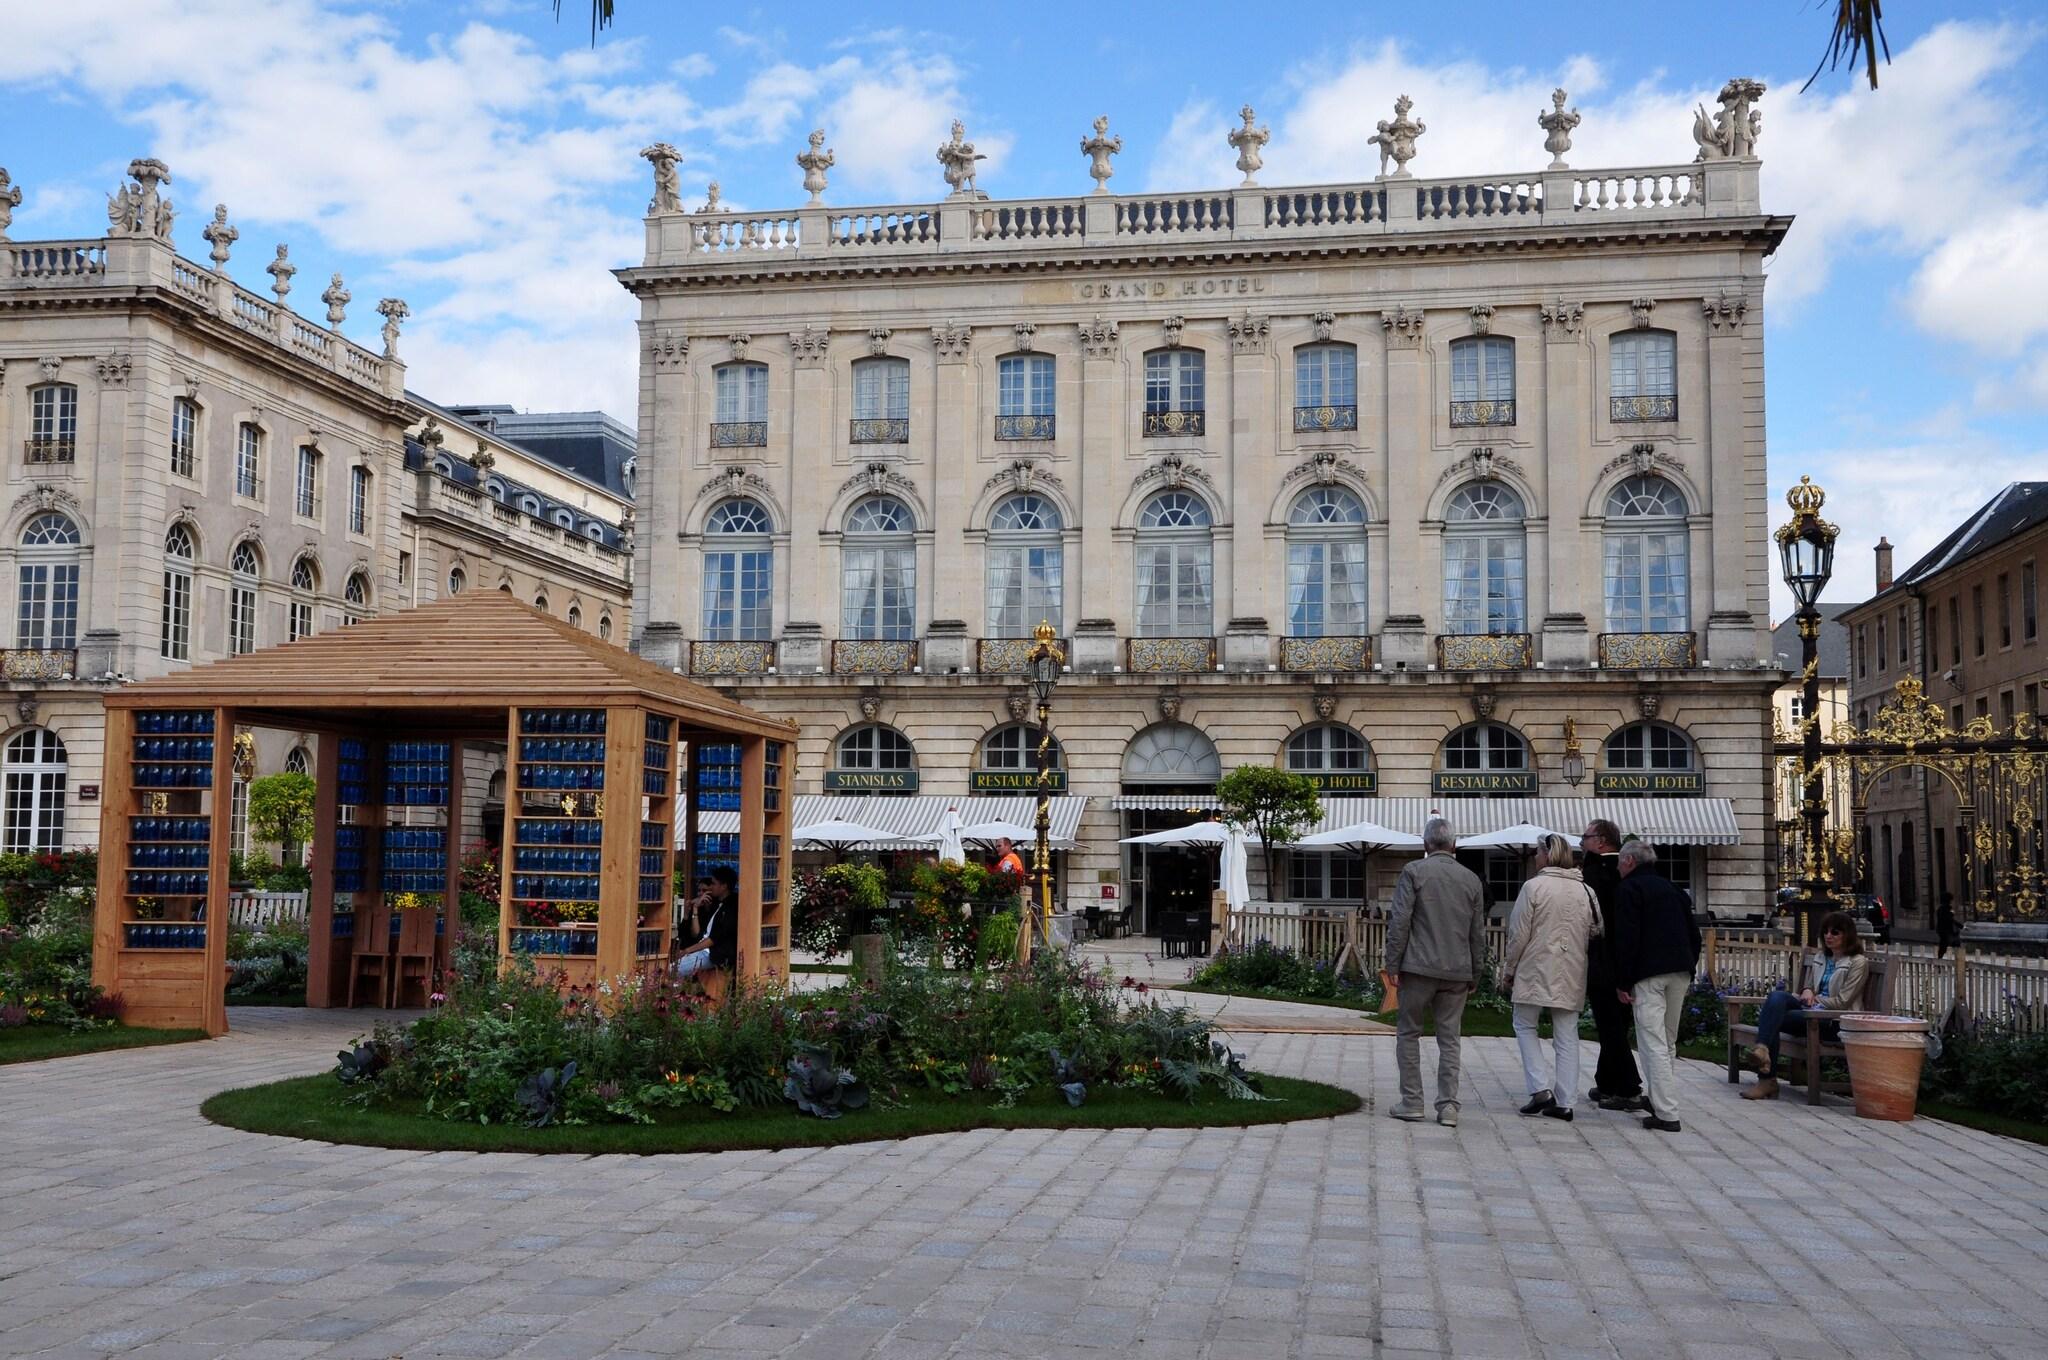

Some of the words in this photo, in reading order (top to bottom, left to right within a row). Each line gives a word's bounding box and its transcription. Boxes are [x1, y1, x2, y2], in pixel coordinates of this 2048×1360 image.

[1082, 281, 1167, 299] GRAND
[1185, 277, 1264, 296] HOTEL
[838, 774, 904, 788] STANISLAS
[1331, 776, 1374, 789] HOTEL
[1440, 776, 1530, 790] RESTAURANT
[1600, 776, 1649, 789] GRAND
[1655, 776, 1701, 789] HOTEL
